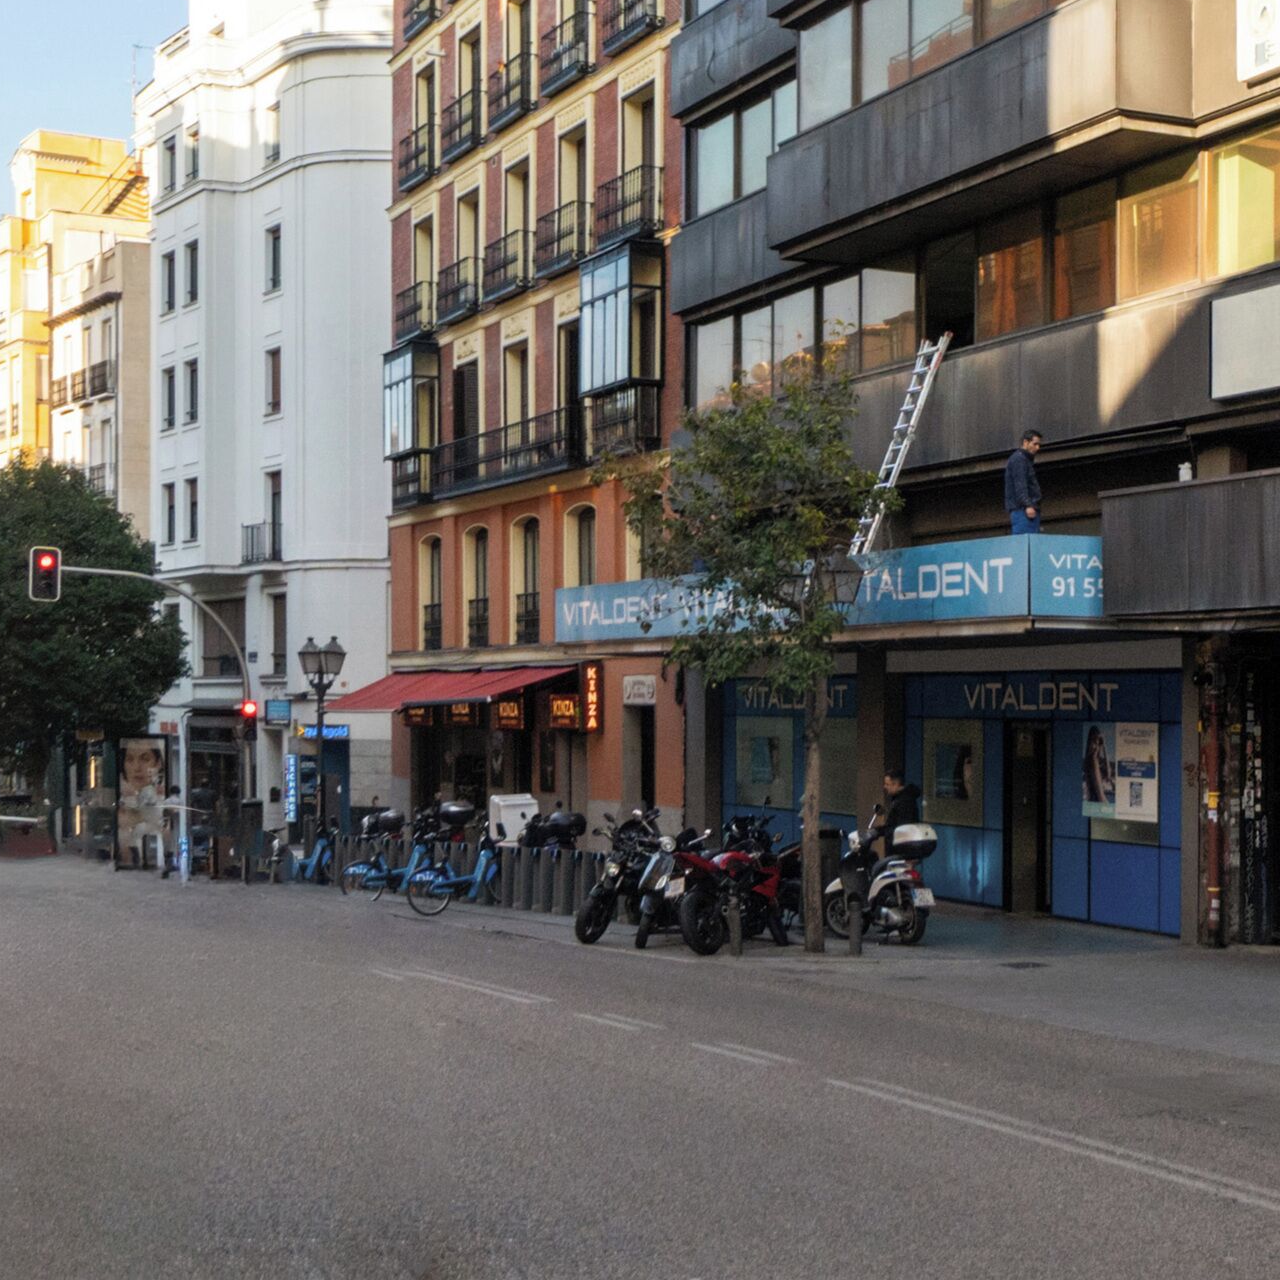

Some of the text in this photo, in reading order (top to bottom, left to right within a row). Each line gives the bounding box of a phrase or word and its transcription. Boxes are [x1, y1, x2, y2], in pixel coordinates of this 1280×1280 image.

[862, 556, 1013, 603] TALDENT
[1051, 577, 1075, 597] 91
[562, 593, 667, 626] VITALDENT
[499, 702, 519, 717] KINZA
[553, 700, 574, 716] KINZA
[587, 667, 597, 730] KINZA
[964, 682, 1119, 712] VITALDENT
[304, 725, 348, 738] quikgold
[289, 757, 297, 818] EXCHANGE
